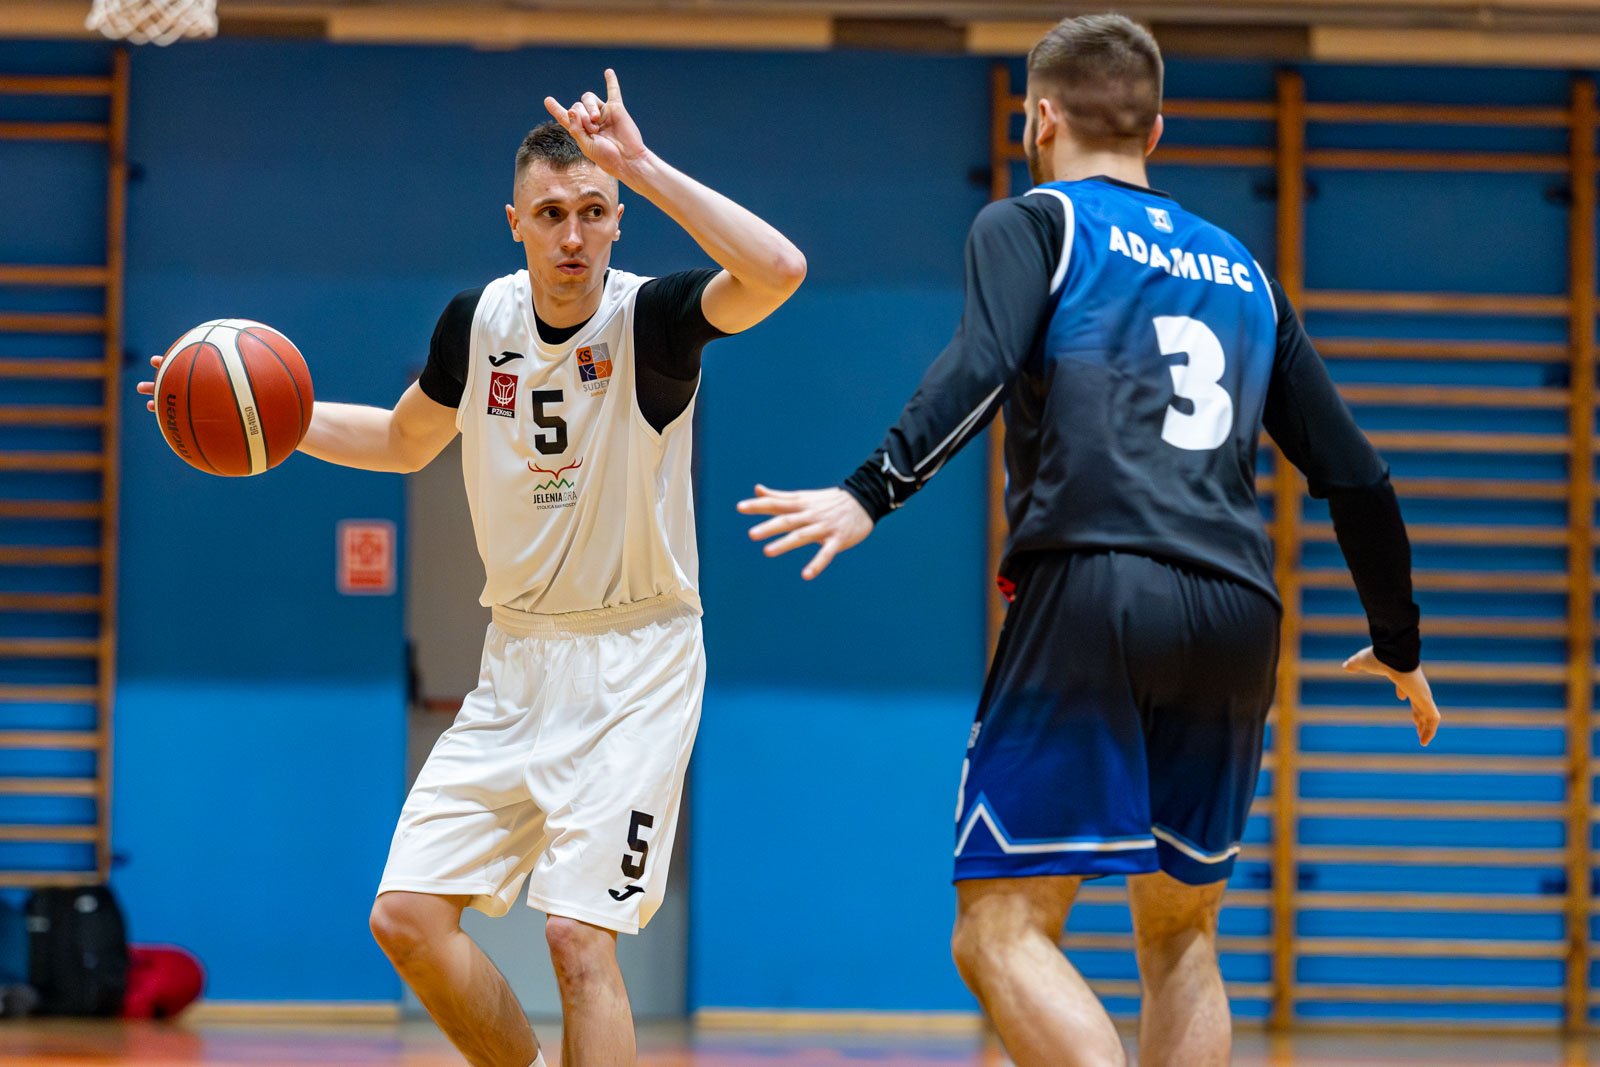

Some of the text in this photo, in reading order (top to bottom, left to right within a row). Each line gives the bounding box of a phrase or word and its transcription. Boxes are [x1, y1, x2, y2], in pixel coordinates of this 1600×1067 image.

[1109, 225, 1254, 293] ADAMIEC
[1153, 315, 1234, 451] 3
[167, 394, 192, 459] molten
[532, 389, 568, 455] 5
[621, 810, 655, 880] 5
